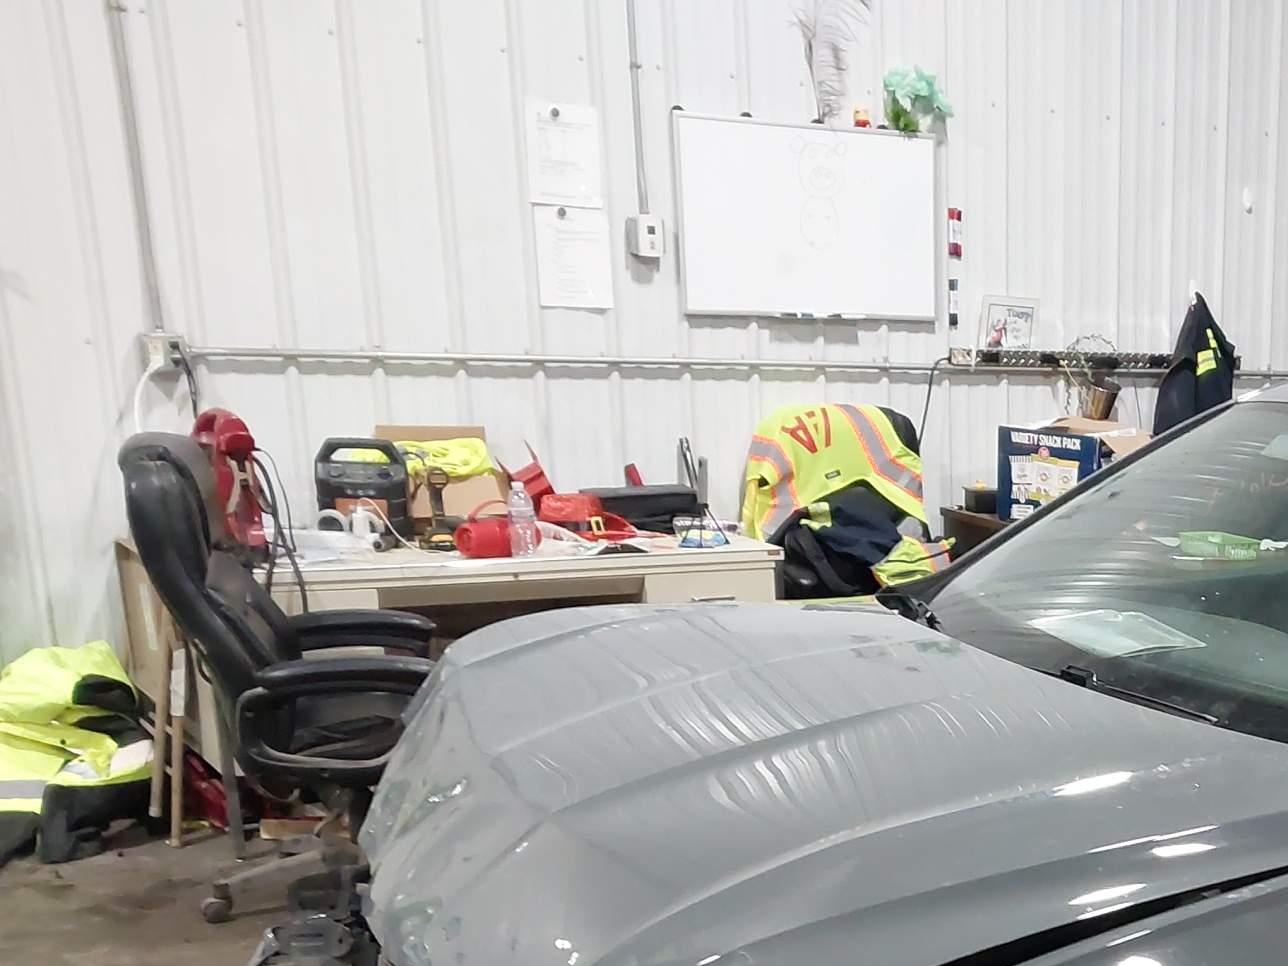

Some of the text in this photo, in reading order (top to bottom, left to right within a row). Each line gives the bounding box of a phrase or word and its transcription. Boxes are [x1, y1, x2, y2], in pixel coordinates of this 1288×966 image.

[1009, 430, 1082, 451] VARIETY SNACK PACK
